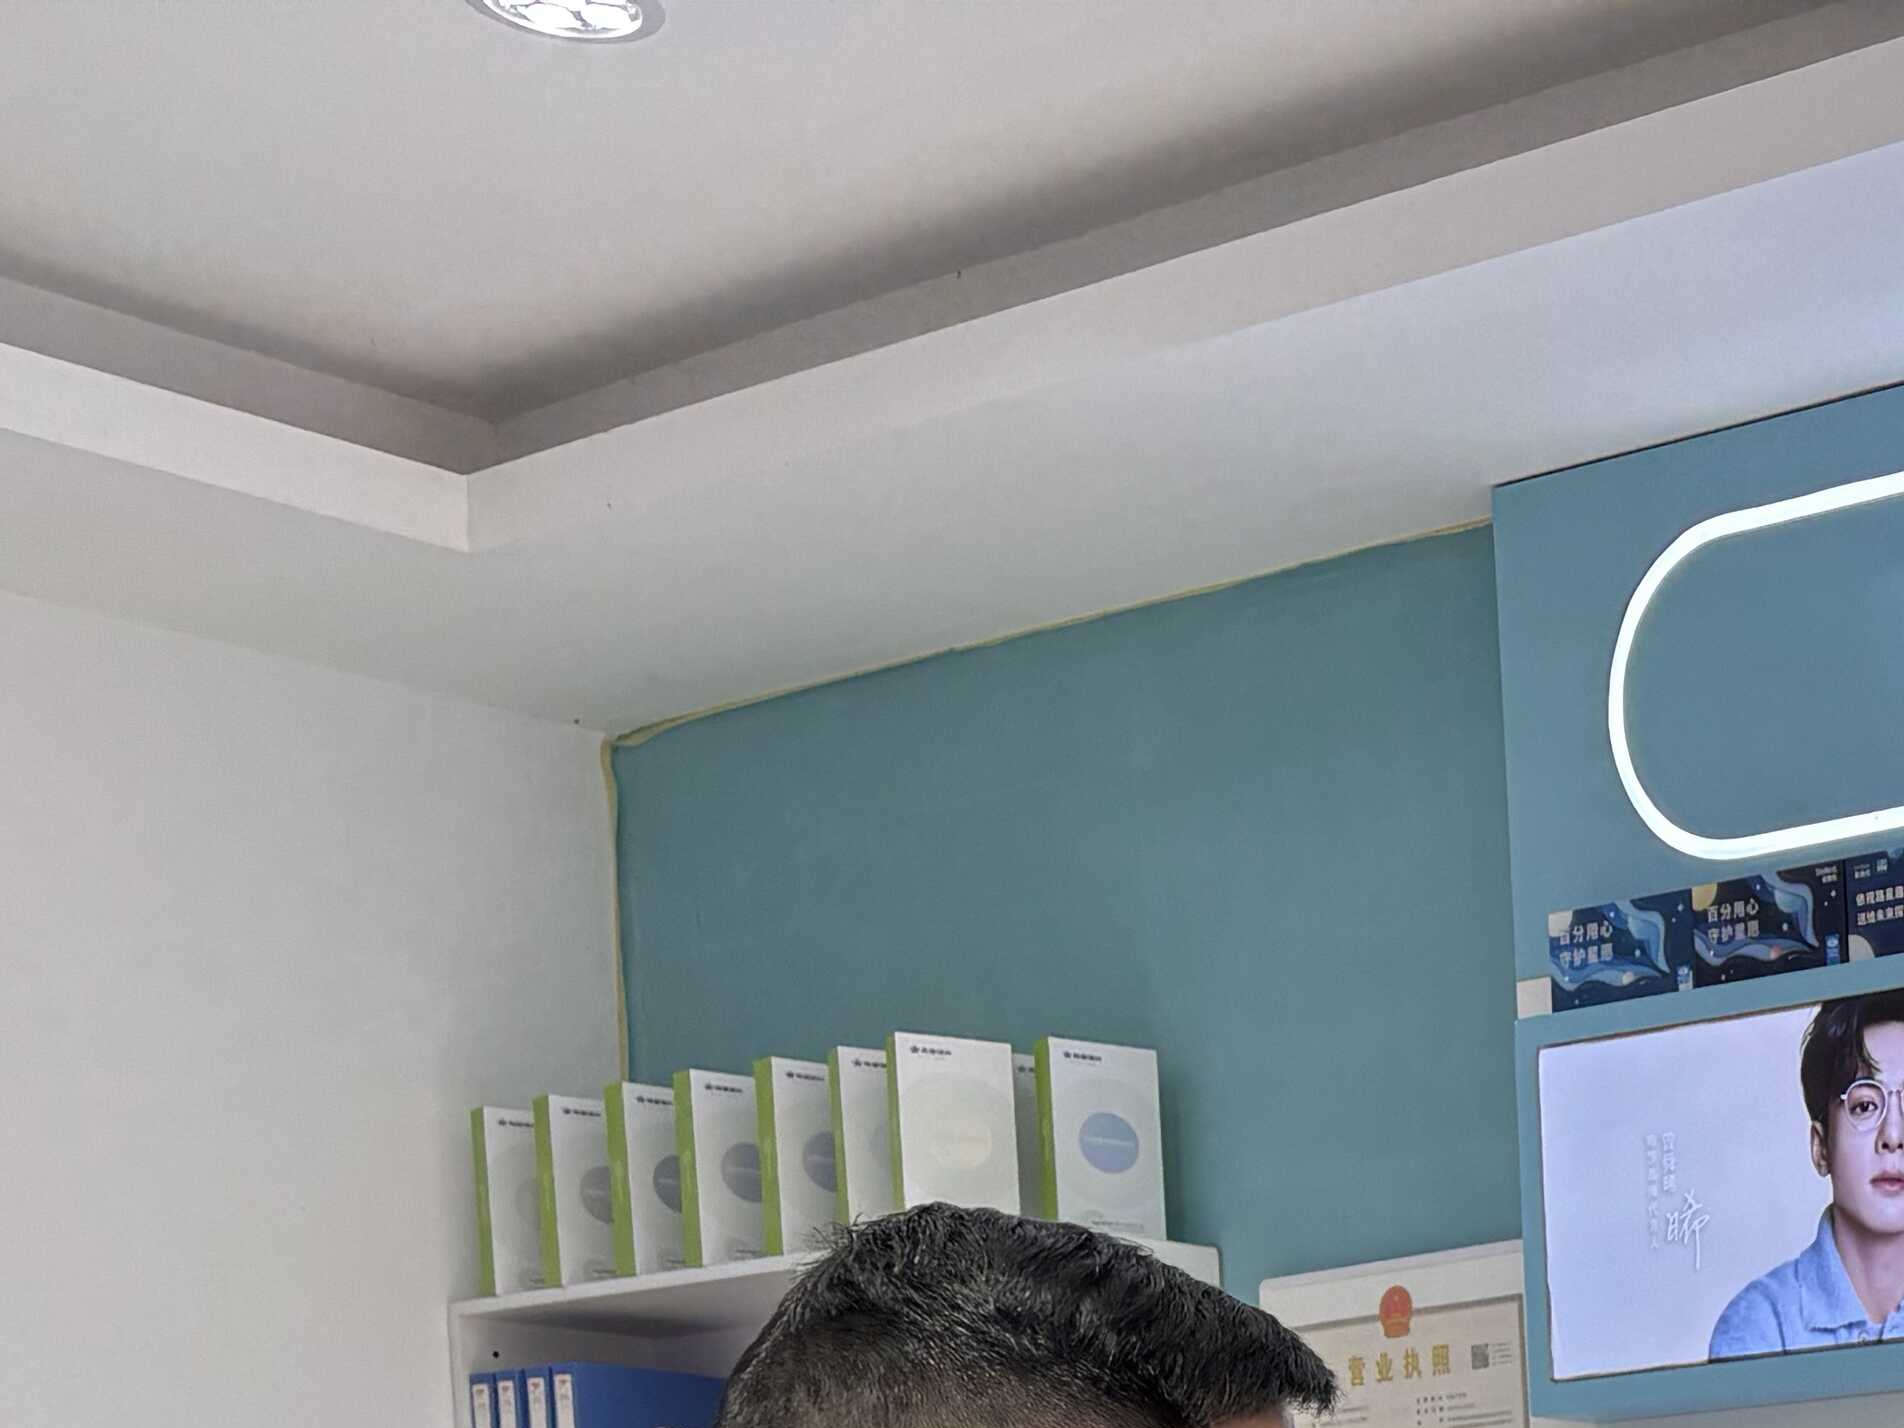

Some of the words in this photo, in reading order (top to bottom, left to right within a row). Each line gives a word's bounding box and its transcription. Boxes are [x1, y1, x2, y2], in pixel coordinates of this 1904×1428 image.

[1707, 899, 1760, 923] 百分用心
[1559, 920, 1613, 945] 百分用心
[1347, 1343, 1451, 1387] 营业执照
